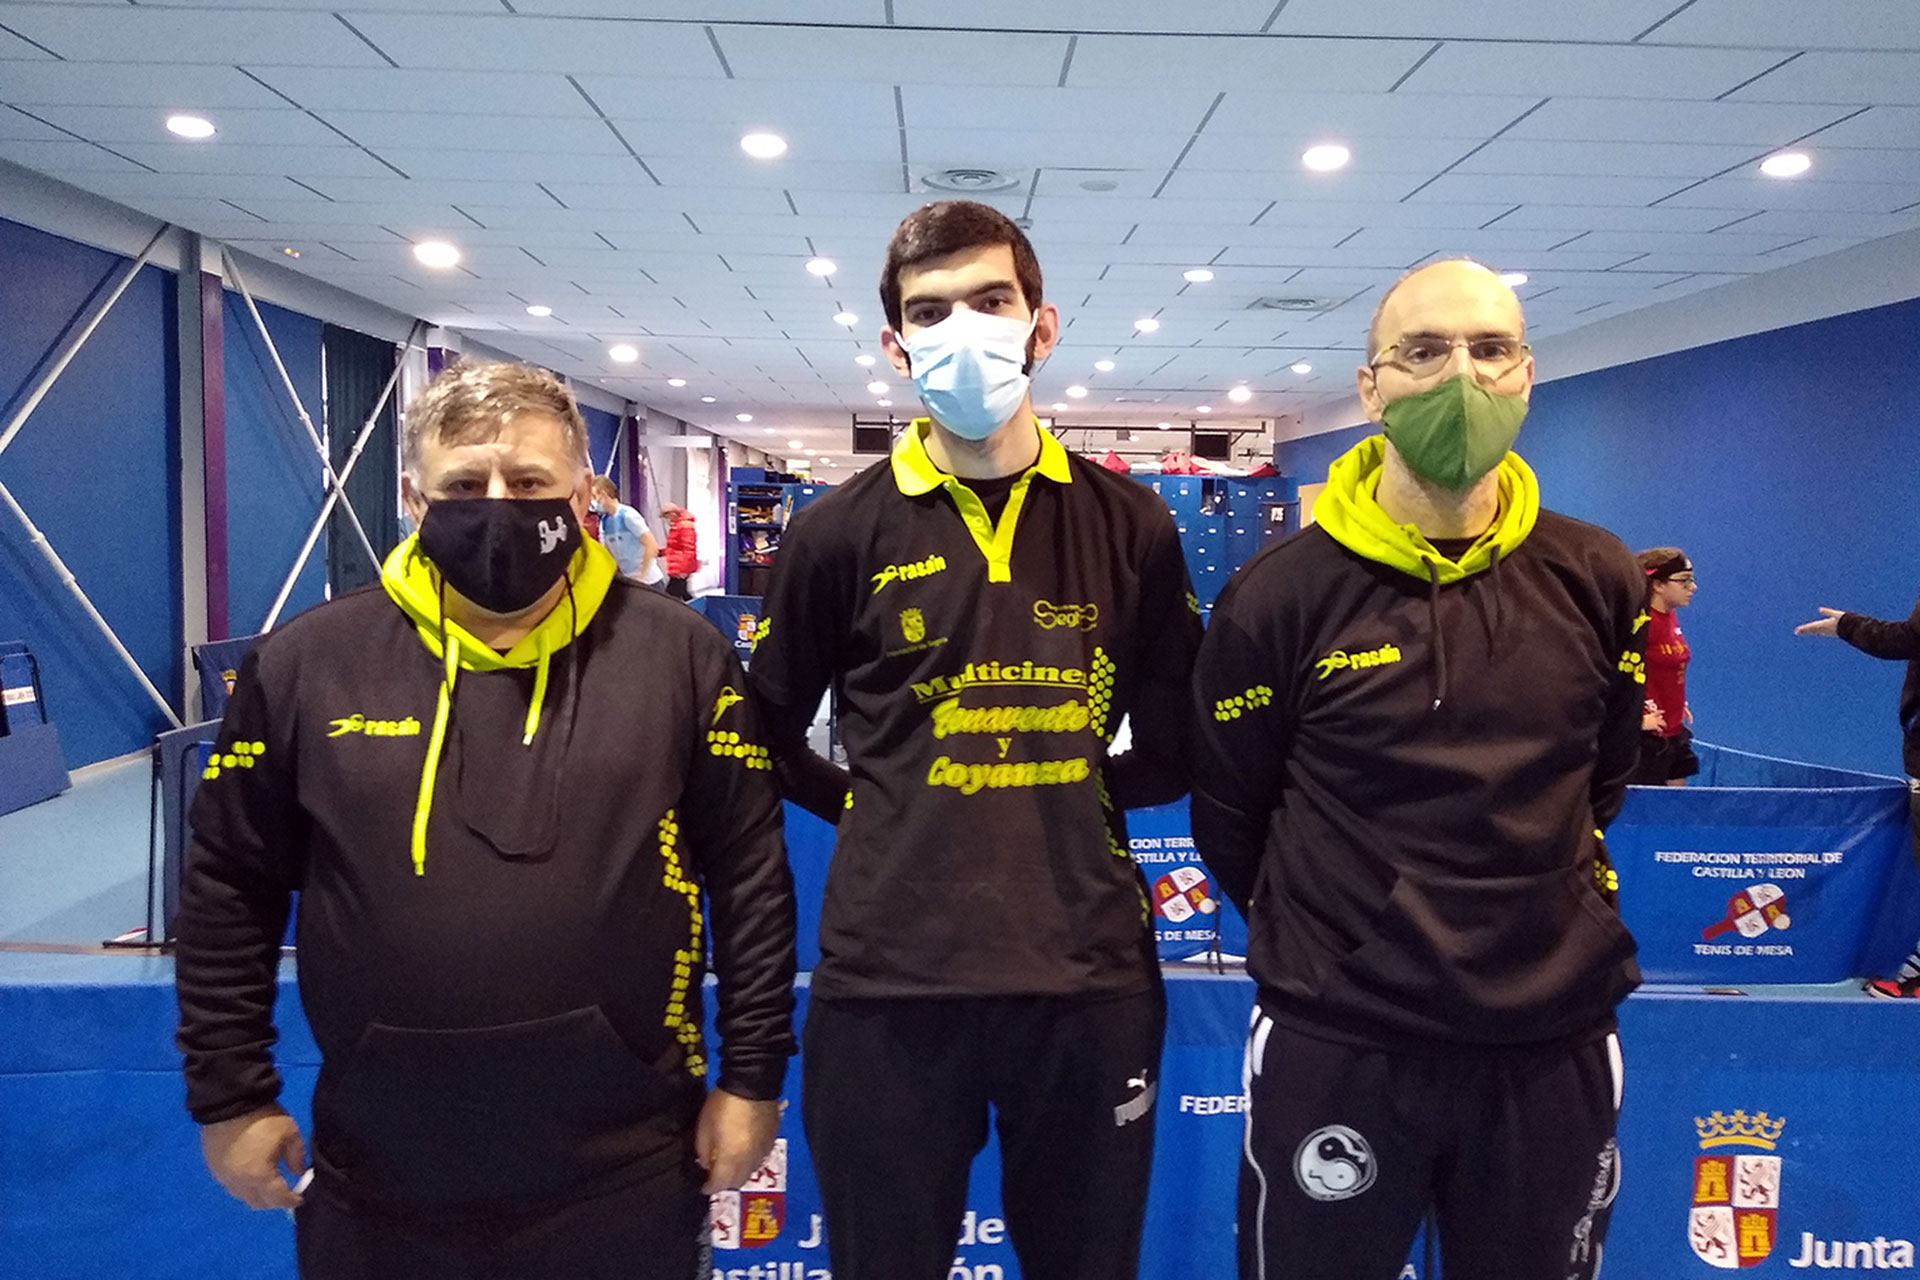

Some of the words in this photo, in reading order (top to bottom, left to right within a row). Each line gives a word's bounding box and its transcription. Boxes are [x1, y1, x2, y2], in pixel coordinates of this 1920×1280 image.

[996, 737, 1012, 759] y
[926, 756, 1090, 796] Coyanza
[1655, 851, 1740, 864] FEDERACION
[1742, 852, 1821, 865] TERRITORIAL
[1822, 851, 1843, 864] DE
[1692, 866, 1755, 879] CASTILLA
[1768, 867, 1805, 879] LEON
[1164, 930, 1182, 942] DE
[1693, 944, 1732, 956] TENIS
[1733, 944, 1754, 956] DE
[1755, 944, 1793, 956] MESA
[1788, 1231, 1914, 1269] Junta
